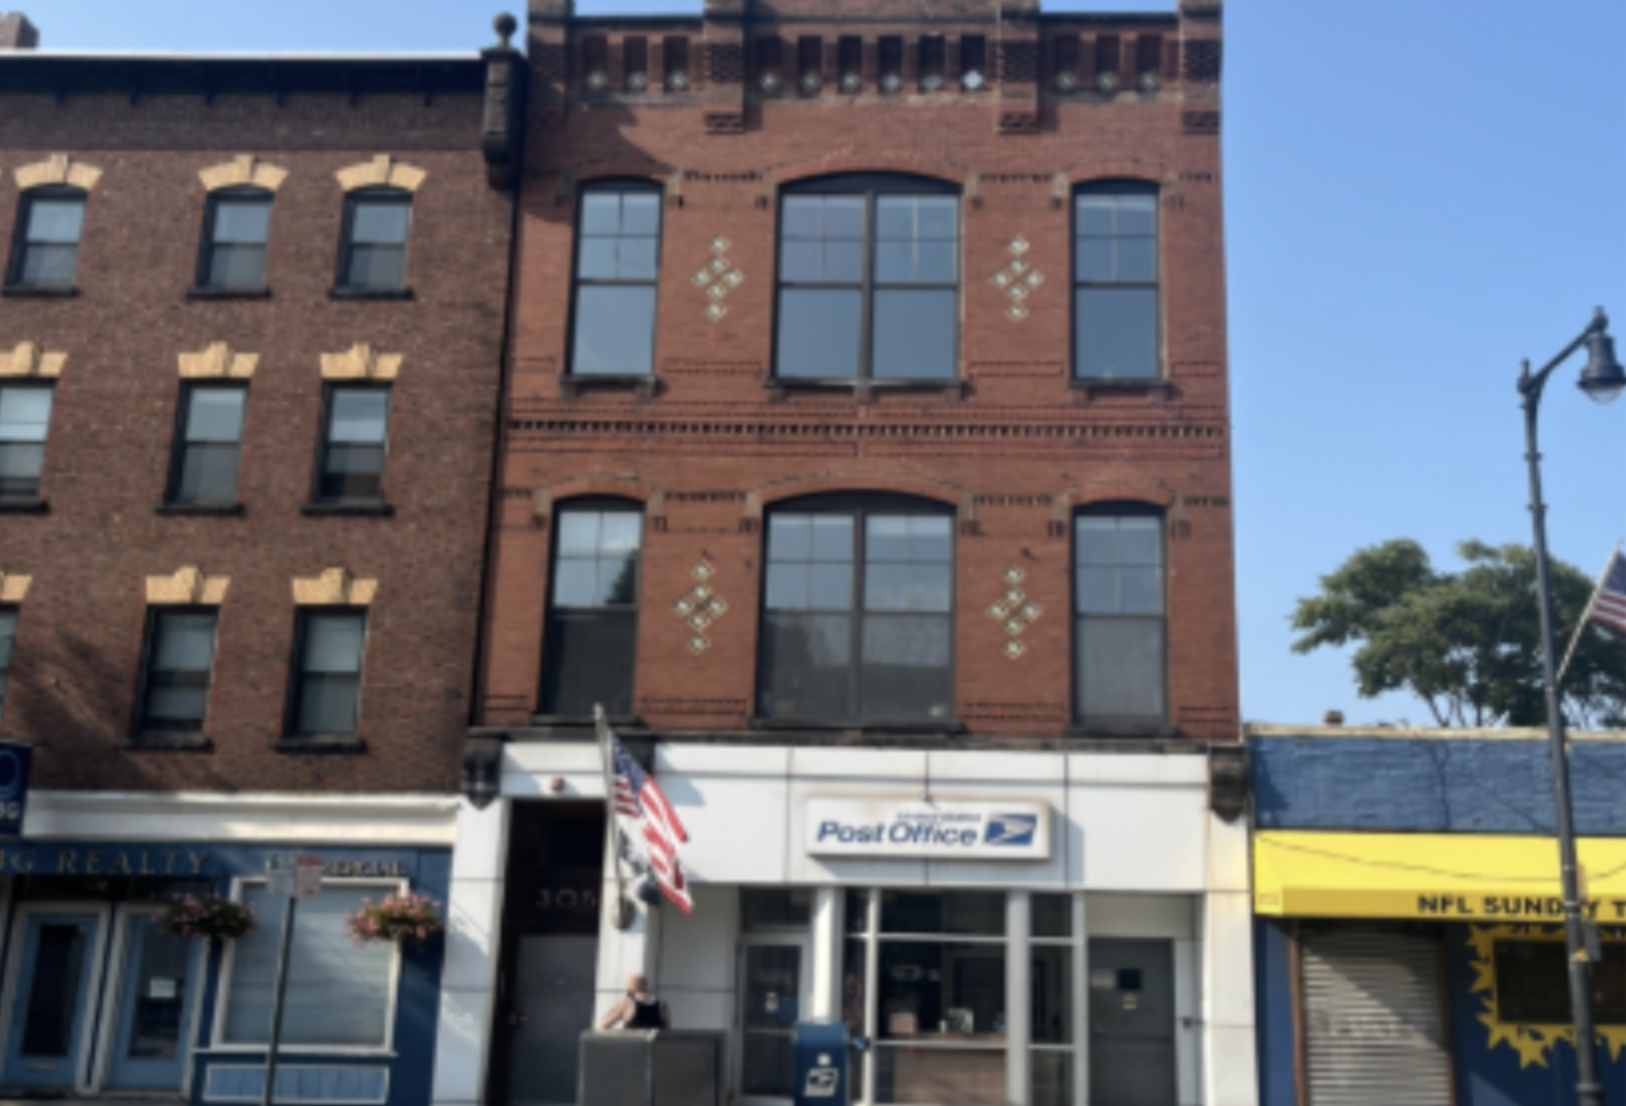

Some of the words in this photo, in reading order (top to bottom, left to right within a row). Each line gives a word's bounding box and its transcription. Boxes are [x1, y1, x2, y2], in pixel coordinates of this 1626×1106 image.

[816, 820, 885, 844] Post
[888, 820, 978, 847] Office
[57, 849, 209, 875] REALTY
[1417, 894, 1474, 915] NFL
[1483, 896, 1601, 918] SUNDY
